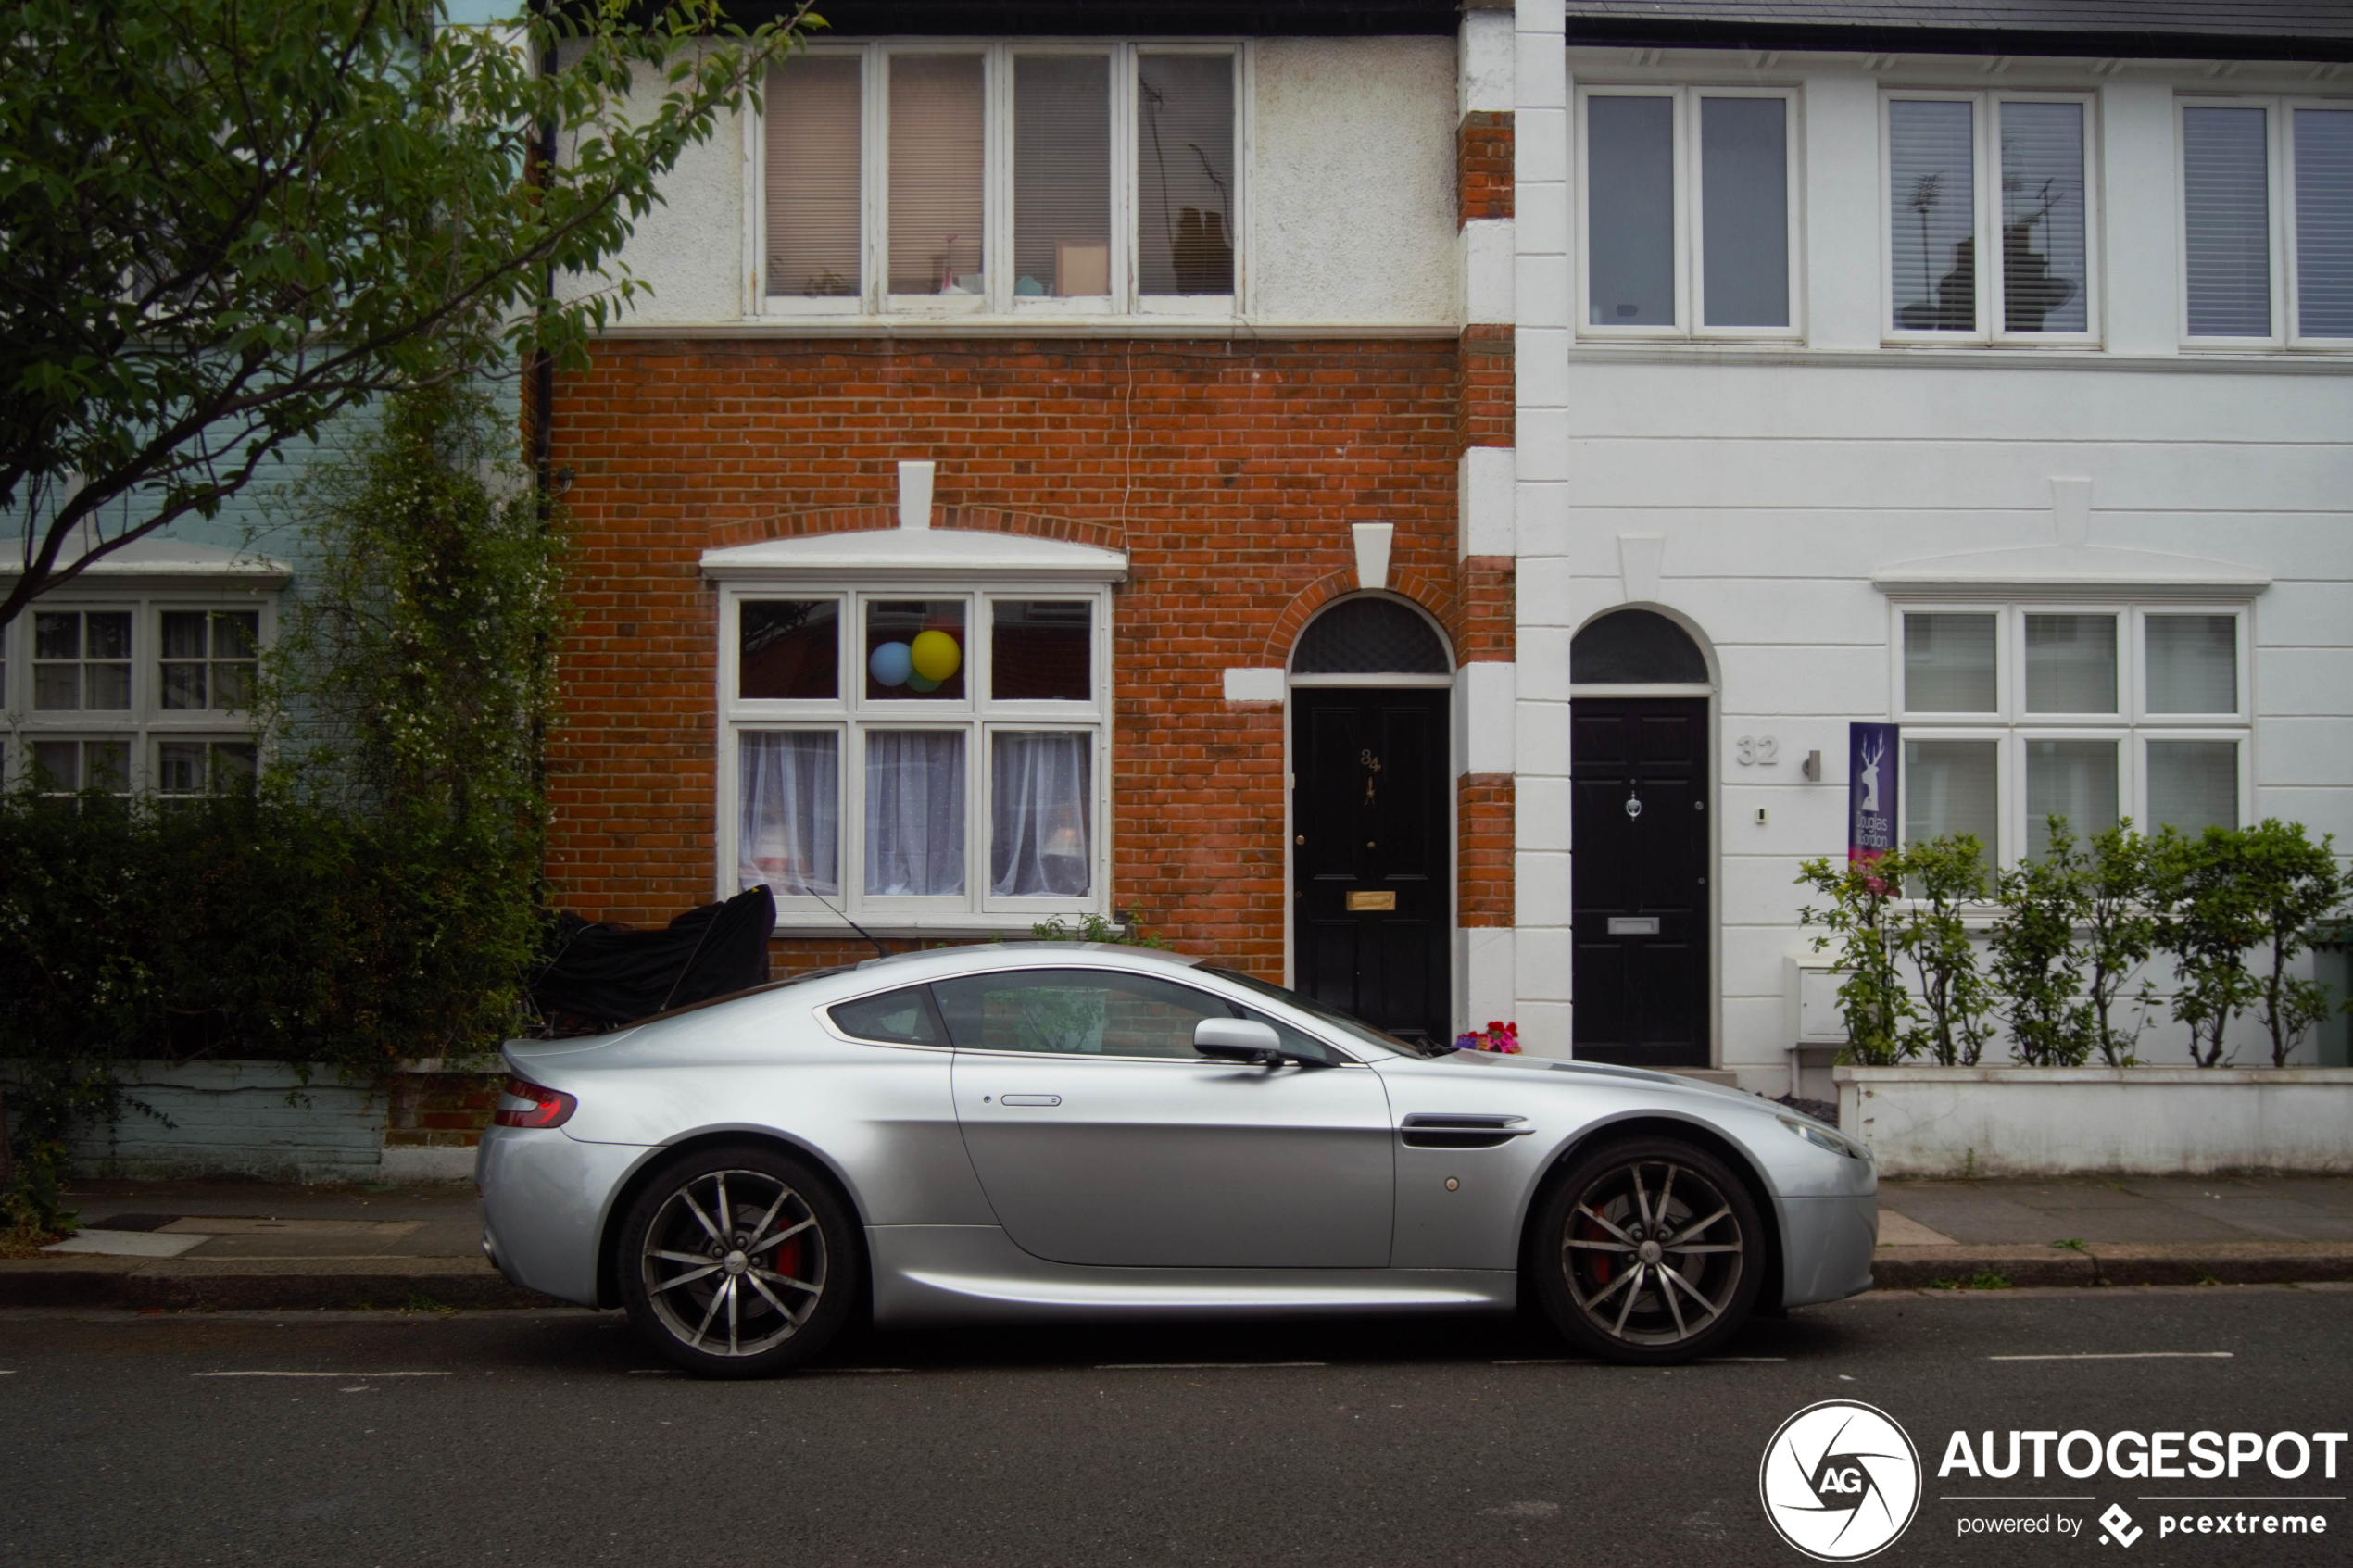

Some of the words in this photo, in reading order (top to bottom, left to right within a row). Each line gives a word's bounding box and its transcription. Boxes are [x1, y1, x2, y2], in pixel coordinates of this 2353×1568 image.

[1360, 748, 1381, 772] 34
[1737, 734, 1779, 765] 32
[1856, 811, 1887, 833] Douglas
